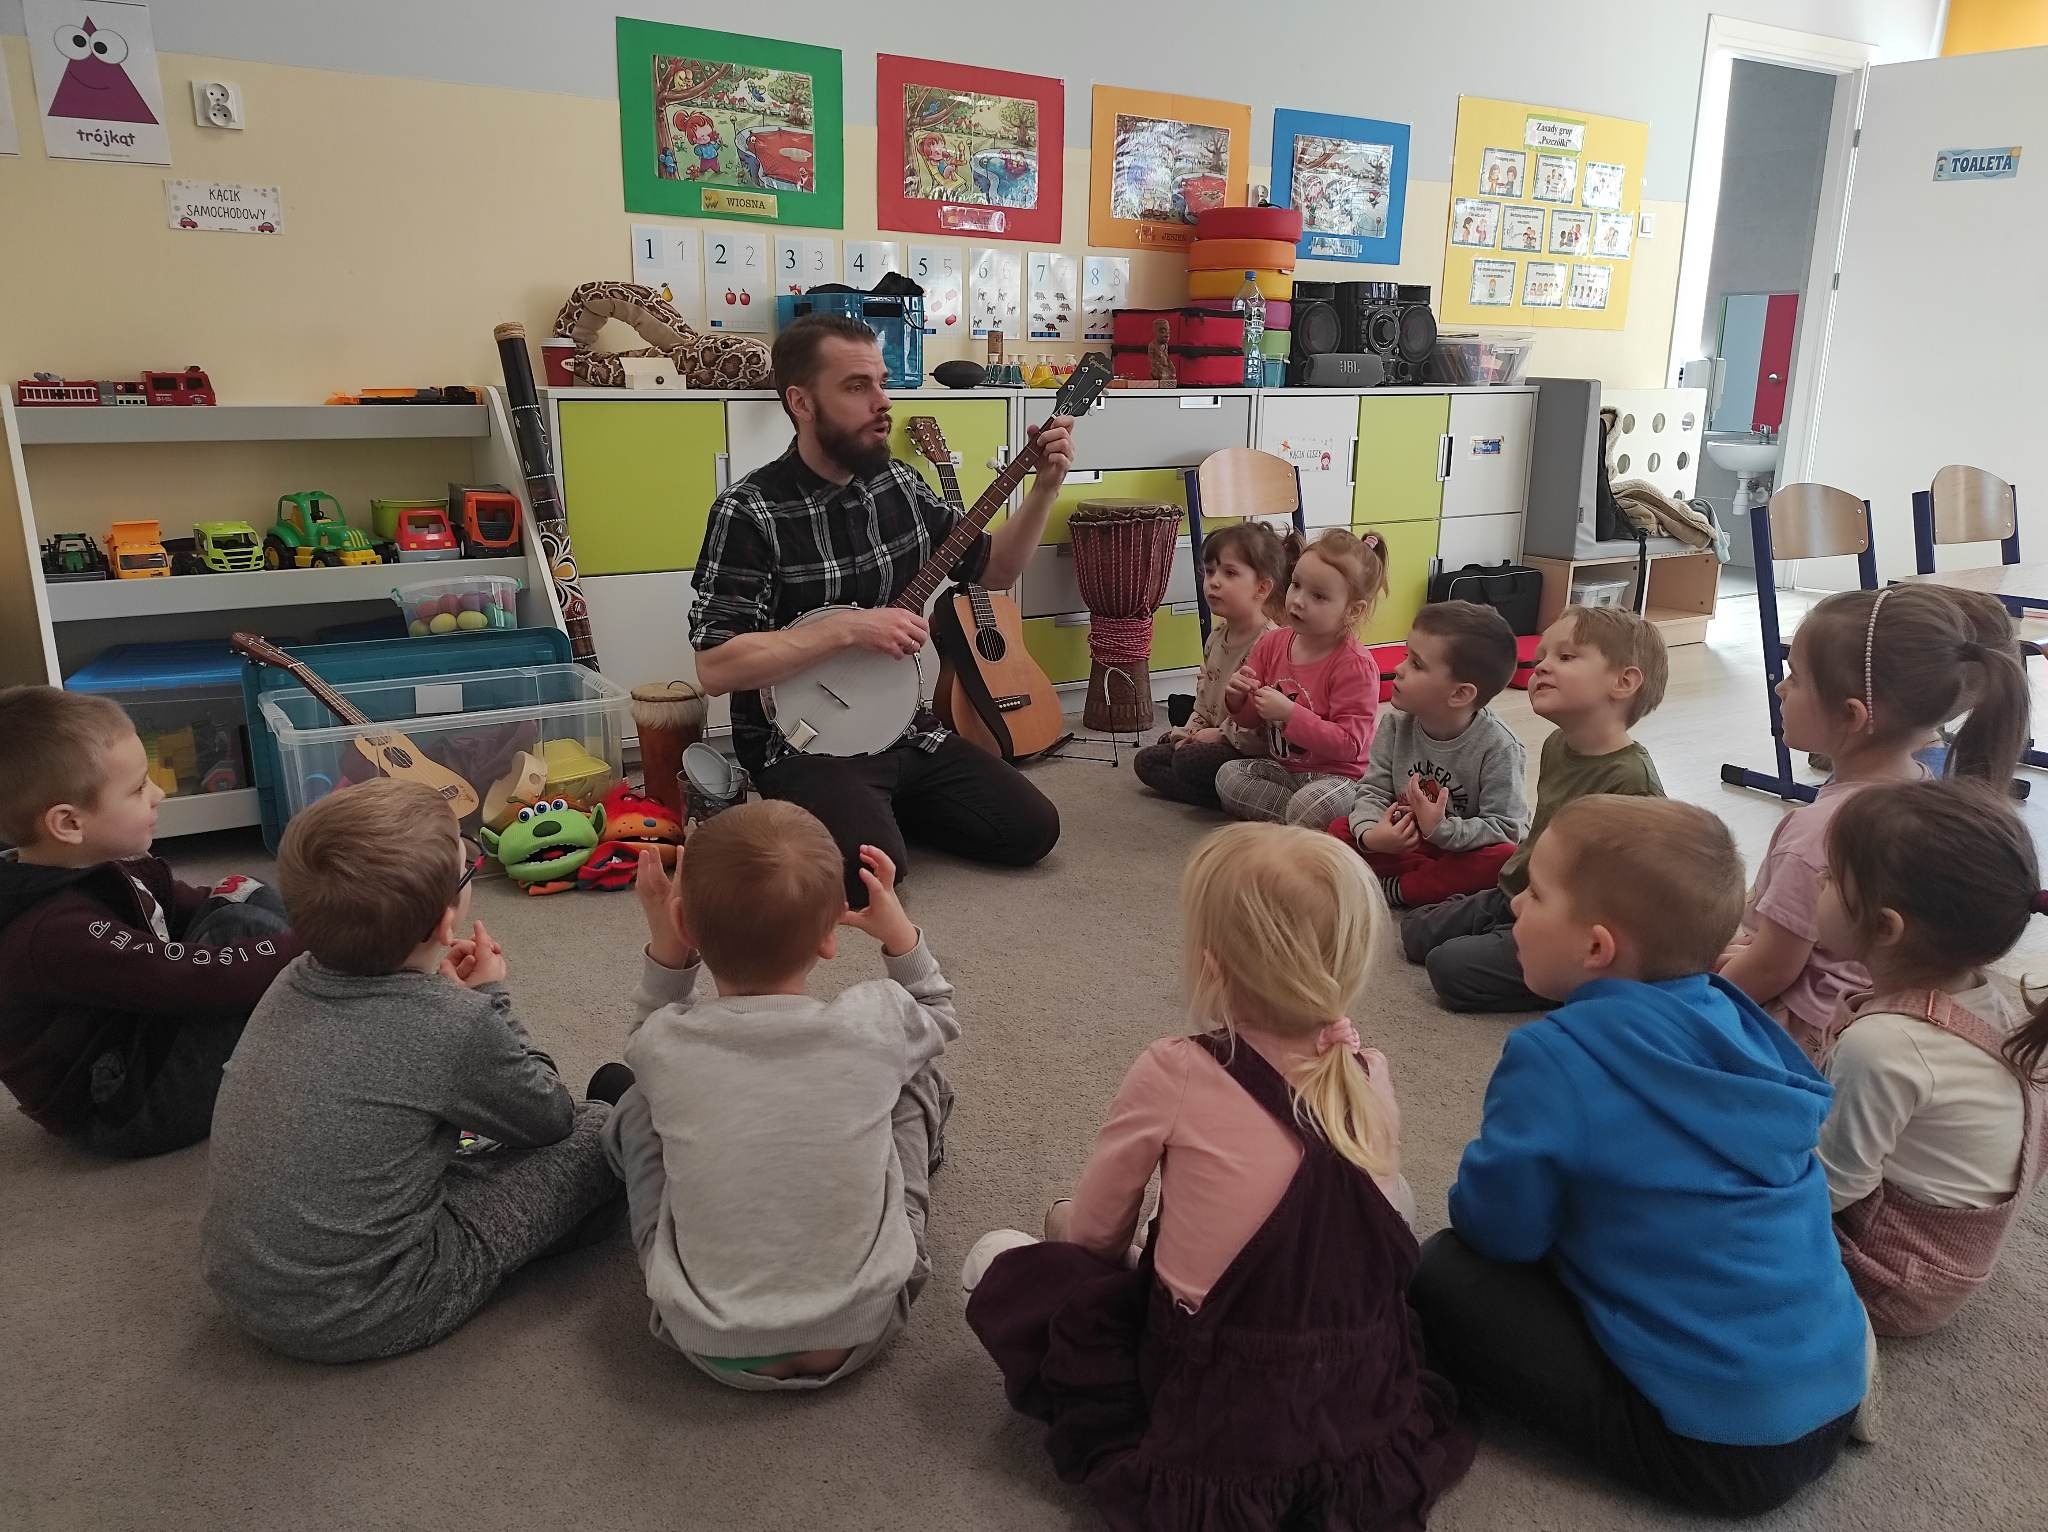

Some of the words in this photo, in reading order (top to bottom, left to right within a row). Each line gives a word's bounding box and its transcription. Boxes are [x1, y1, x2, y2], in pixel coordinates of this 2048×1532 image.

[76, 128, 136, 147] trójkąt
[1536, 122, 1559, 136] Zasady
[1951, 155, 2012, 172] TOALETA
[208, 188, 241, 202] KĄCIK
[726, 197, 766, 210] WIOSNA
[186, 204, 266, 221] SAMOCHODOWY
[645, 238, 654, 259] 1
[715, 244, 727, 264] 2
[745, 245, 755, 266] 2
[785, 249, 796, 269] 3
[814, 250, 824, 271] 3
[853, 253, 864, 273] 4
[918, 257, 928, 276] 5
[943, 258, 953, 277] 5
[978, 260, 988, 279] 6
[1036, 264, 1046, 282] 7
[1091, 267, 1100, 286] 8
[1112, 268, 1121, 287] 8
[1340, 360, 1361, 374] JBL
[88, 920, 276, 965] DISCOVER
